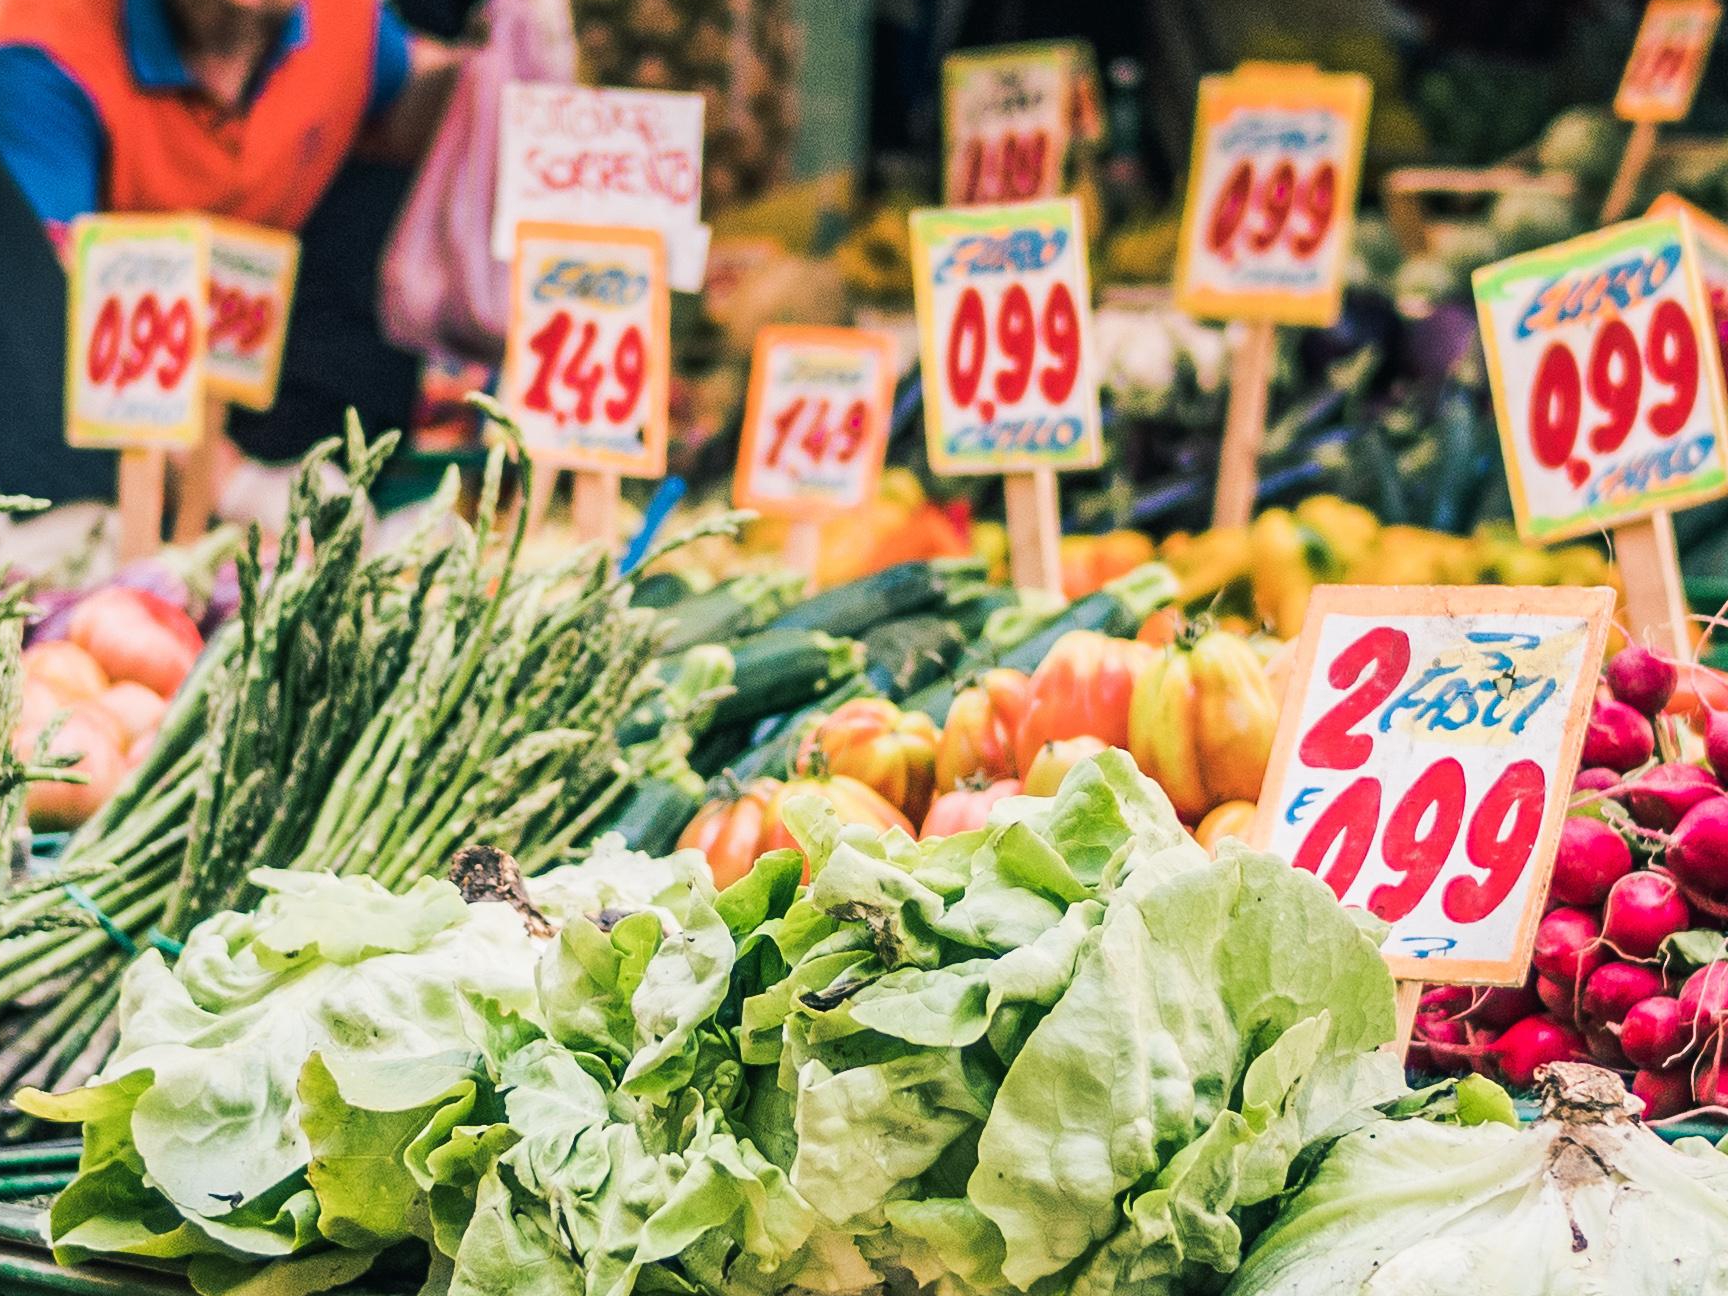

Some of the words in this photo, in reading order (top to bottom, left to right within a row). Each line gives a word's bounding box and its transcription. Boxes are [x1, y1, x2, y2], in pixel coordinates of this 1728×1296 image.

[946, 281, 1082, 425] 0,99
[1527, 297, 1700, 492] 0,99
[1298, 626, 1411, 771] 2
[1291, 755, 1546, 924] 099
